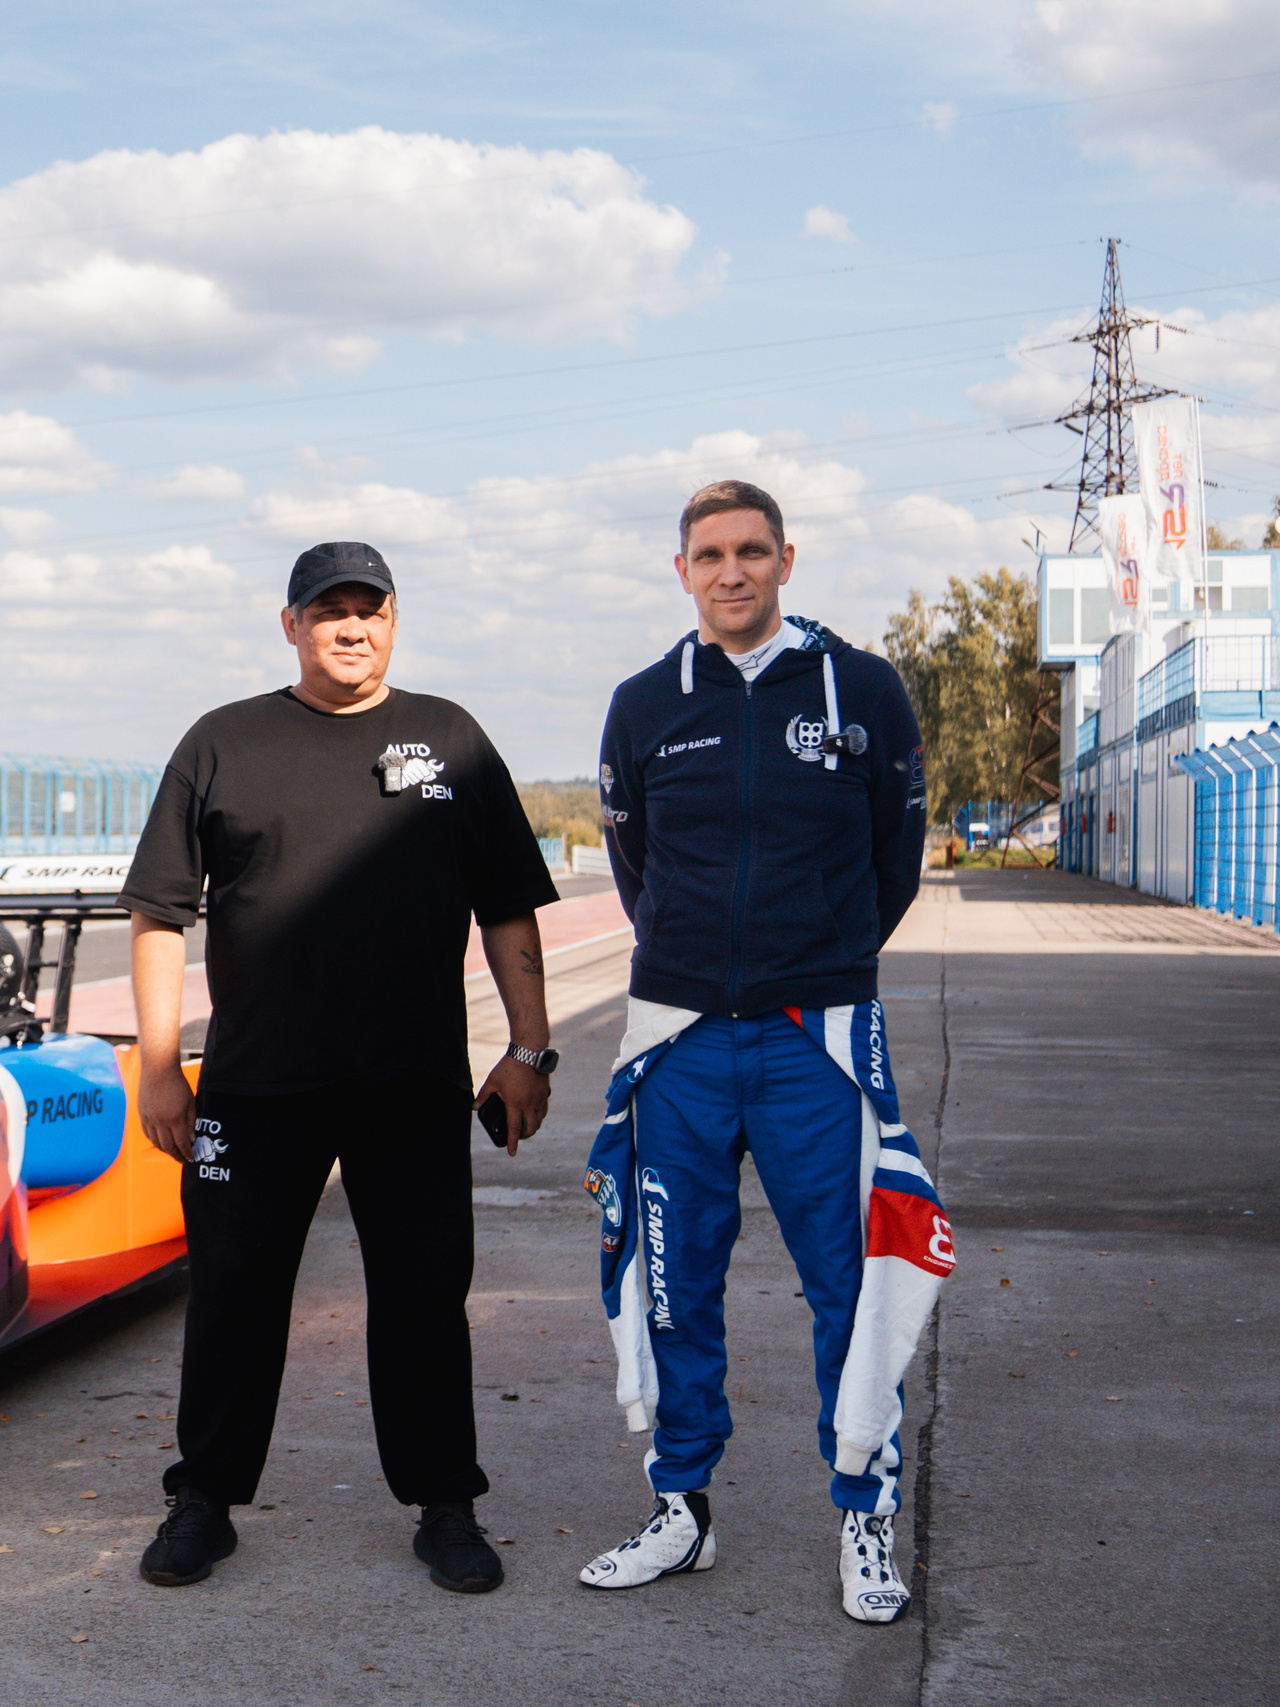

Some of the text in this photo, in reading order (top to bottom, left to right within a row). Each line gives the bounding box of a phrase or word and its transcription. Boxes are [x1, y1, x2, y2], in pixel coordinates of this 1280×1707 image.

[385, 743, 431, 757] AUTO
[667, 736, 722, 755] SMP RACING
[421, 784, 453, 800] DEN
[22, 866, 131, 878] SMP RAC
[869, 999, 885, 1091] RACING
[41, 1089, 104, 1124] RACING
[195, 1117, 222, 1134] UTO
[199, 1164, 230, 1181] DEN
[647, 1200, 665, 1255] SMP
[864, 1594, 908, 1606] OMP
